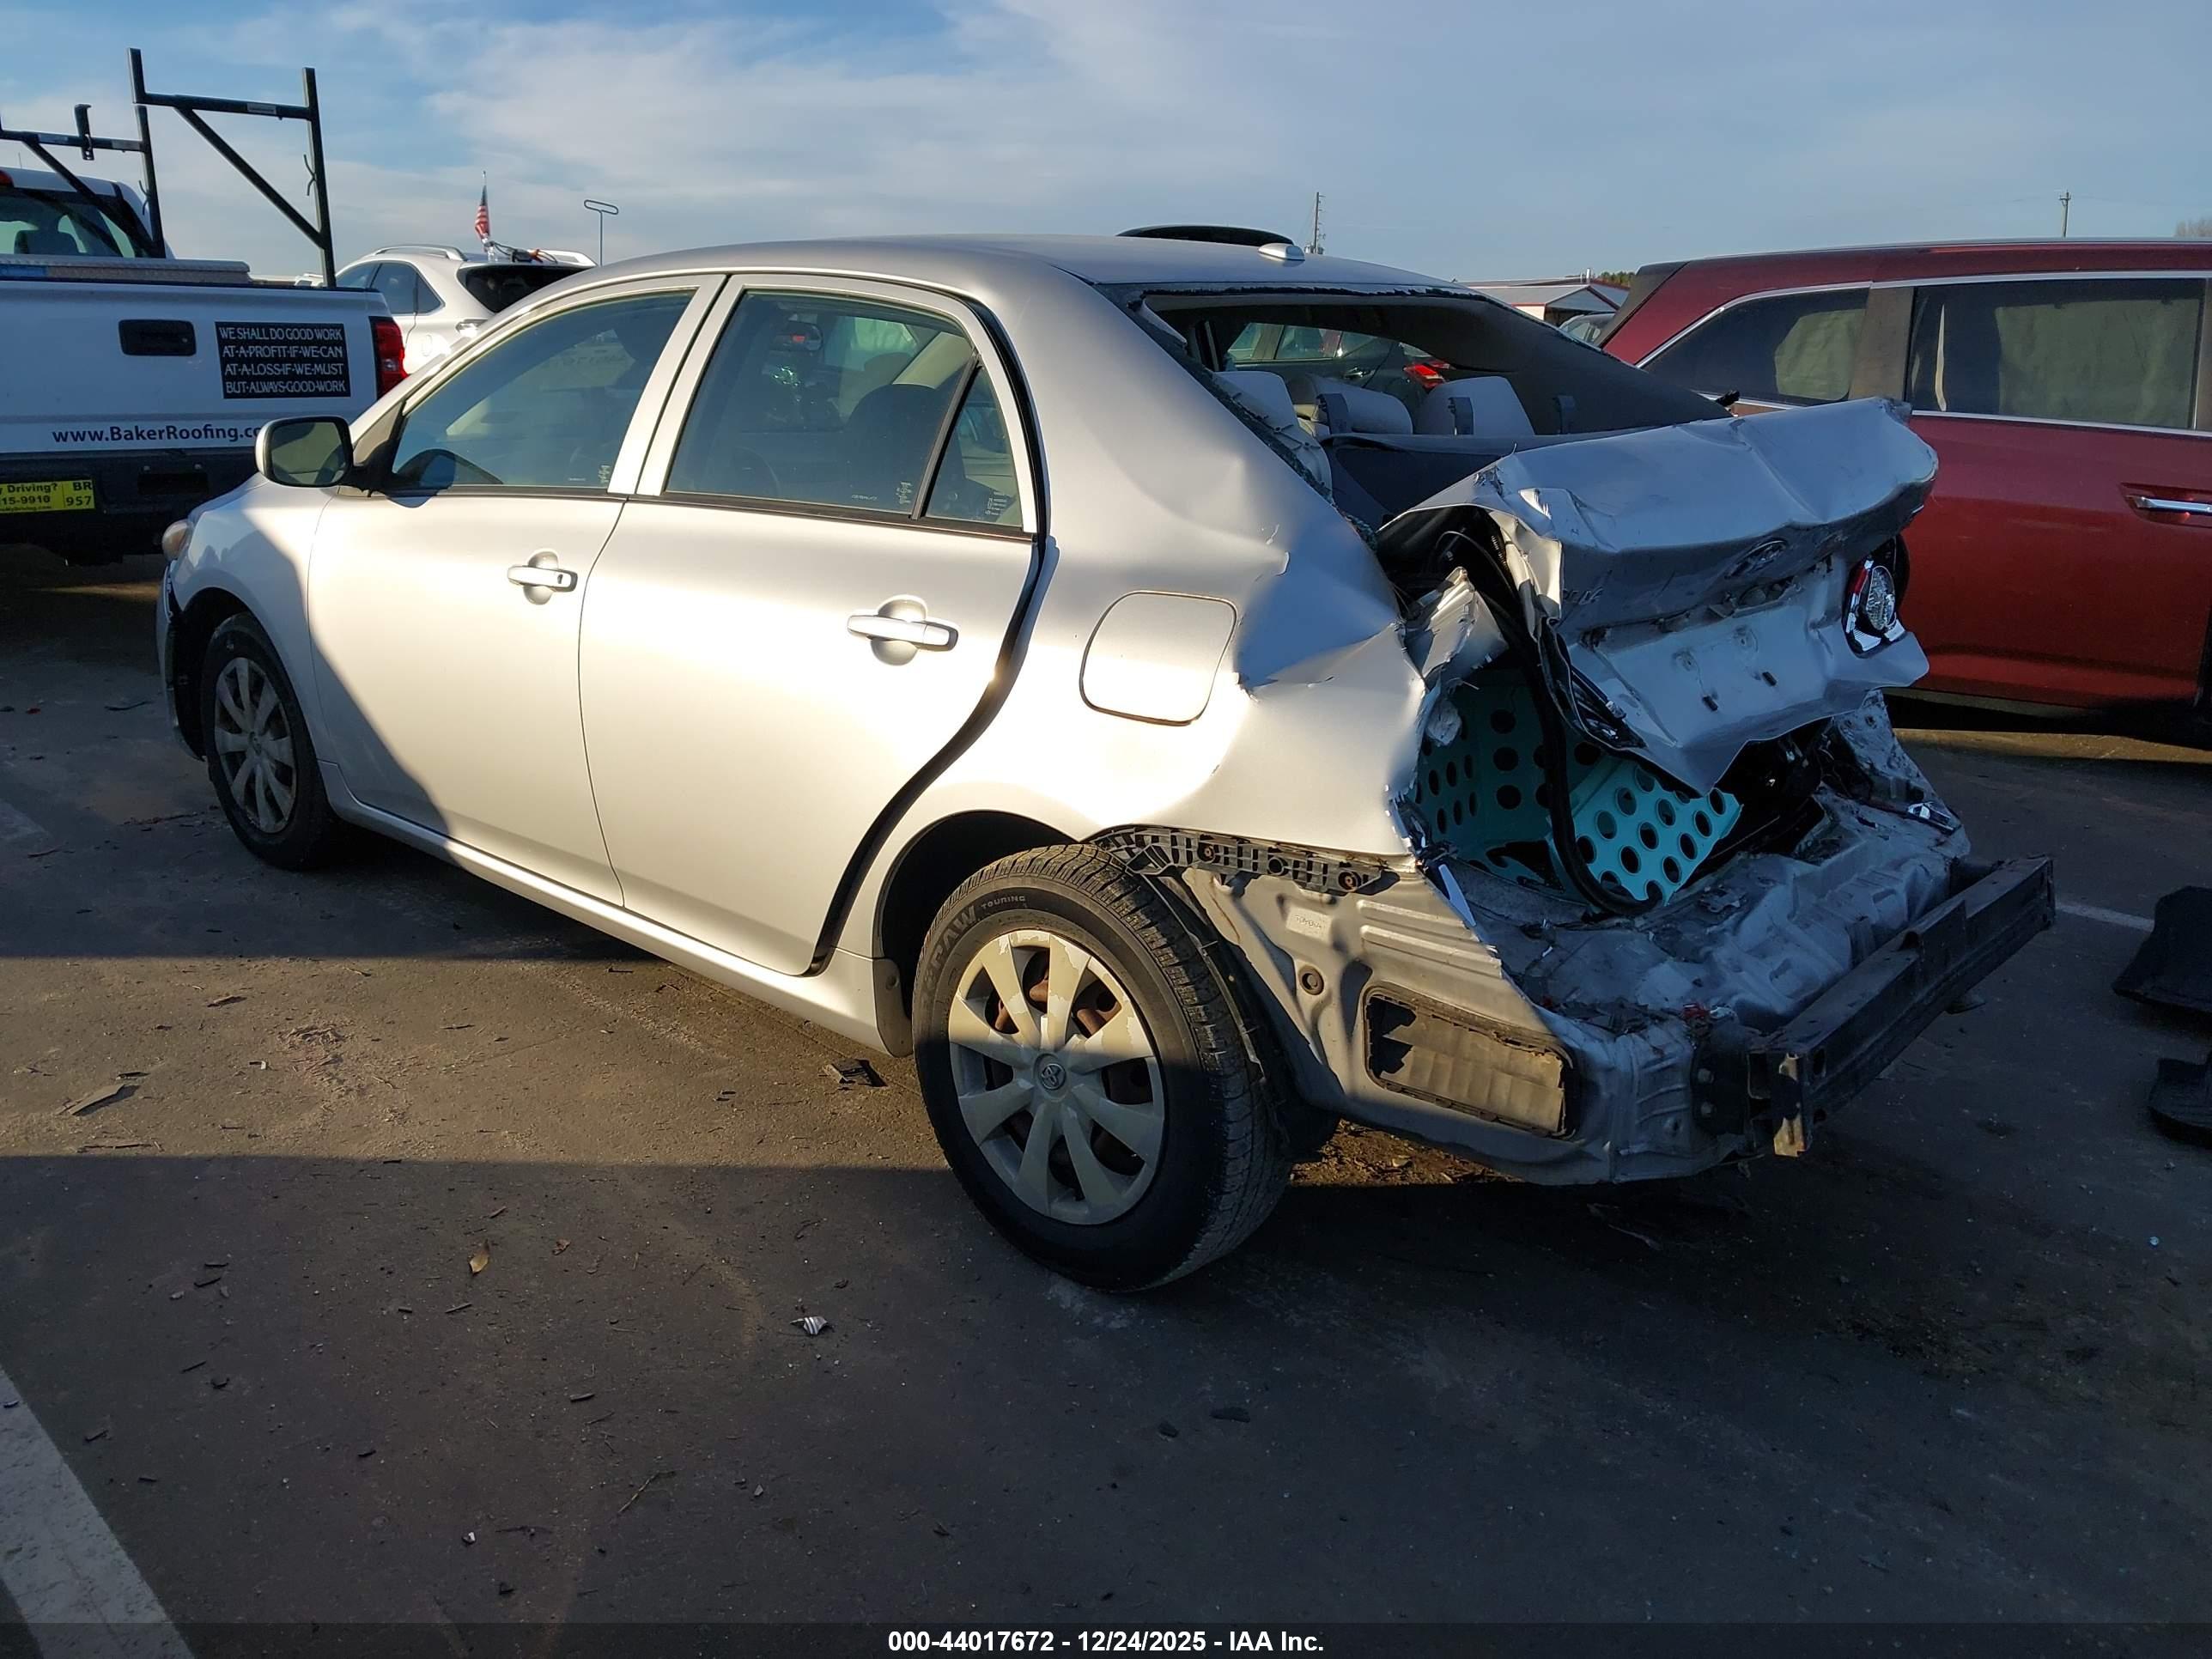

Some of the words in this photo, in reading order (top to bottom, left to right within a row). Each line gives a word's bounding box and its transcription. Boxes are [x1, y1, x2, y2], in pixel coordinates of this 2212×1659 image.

[219, 327, 235, 339] WE
[237, 327, 269, 339] SHALL
[270, 328, 284, 339] DO
[286, 328, 313, 340] GOOD
[315, 329, 343, 340] WORK
[7, 483, 58, 493] Driving?
[73, 482, 92, 491] BR
[66, 495, 91, 506] 957
[981, 896, 1026, 910] TOURING
